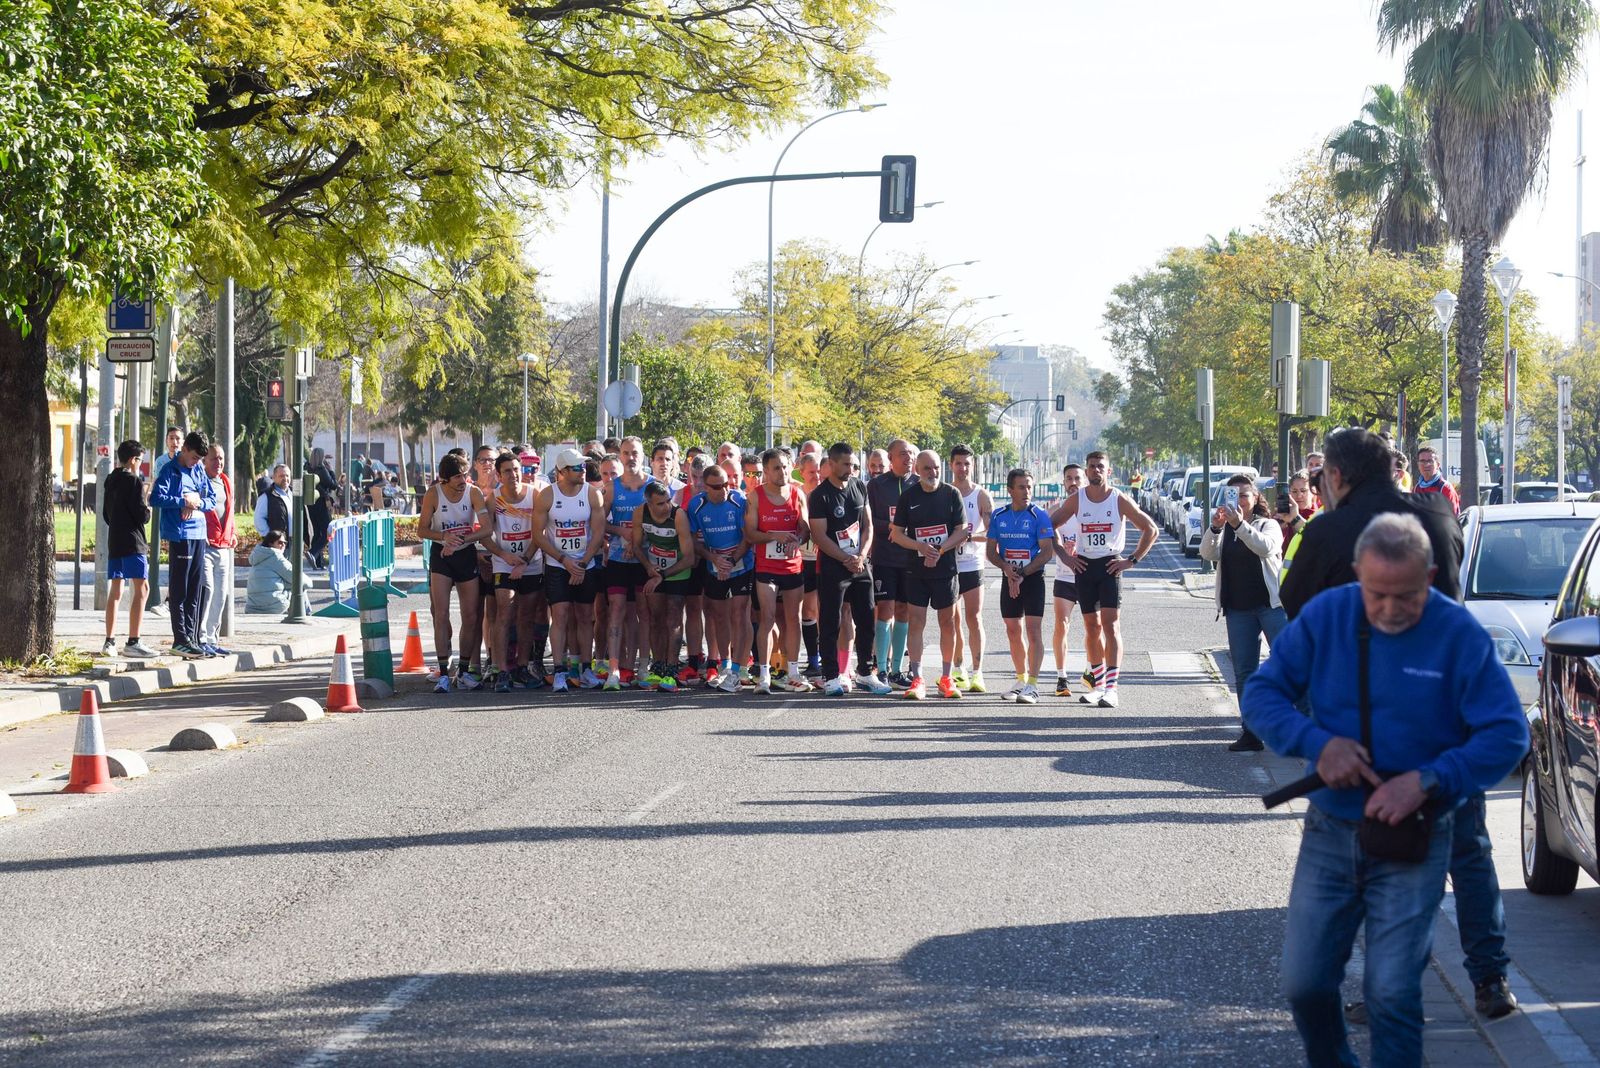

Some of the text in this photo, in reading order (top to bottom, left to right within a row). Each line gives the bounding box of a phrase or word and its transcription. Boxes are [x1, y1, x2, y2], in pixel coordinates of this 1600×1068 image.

[561, 538, 581, 550] 216
[1087, 533, 1106, 546] 138
[510, 541, 524, 553] 34
[655, 557, 667, 568] 18
